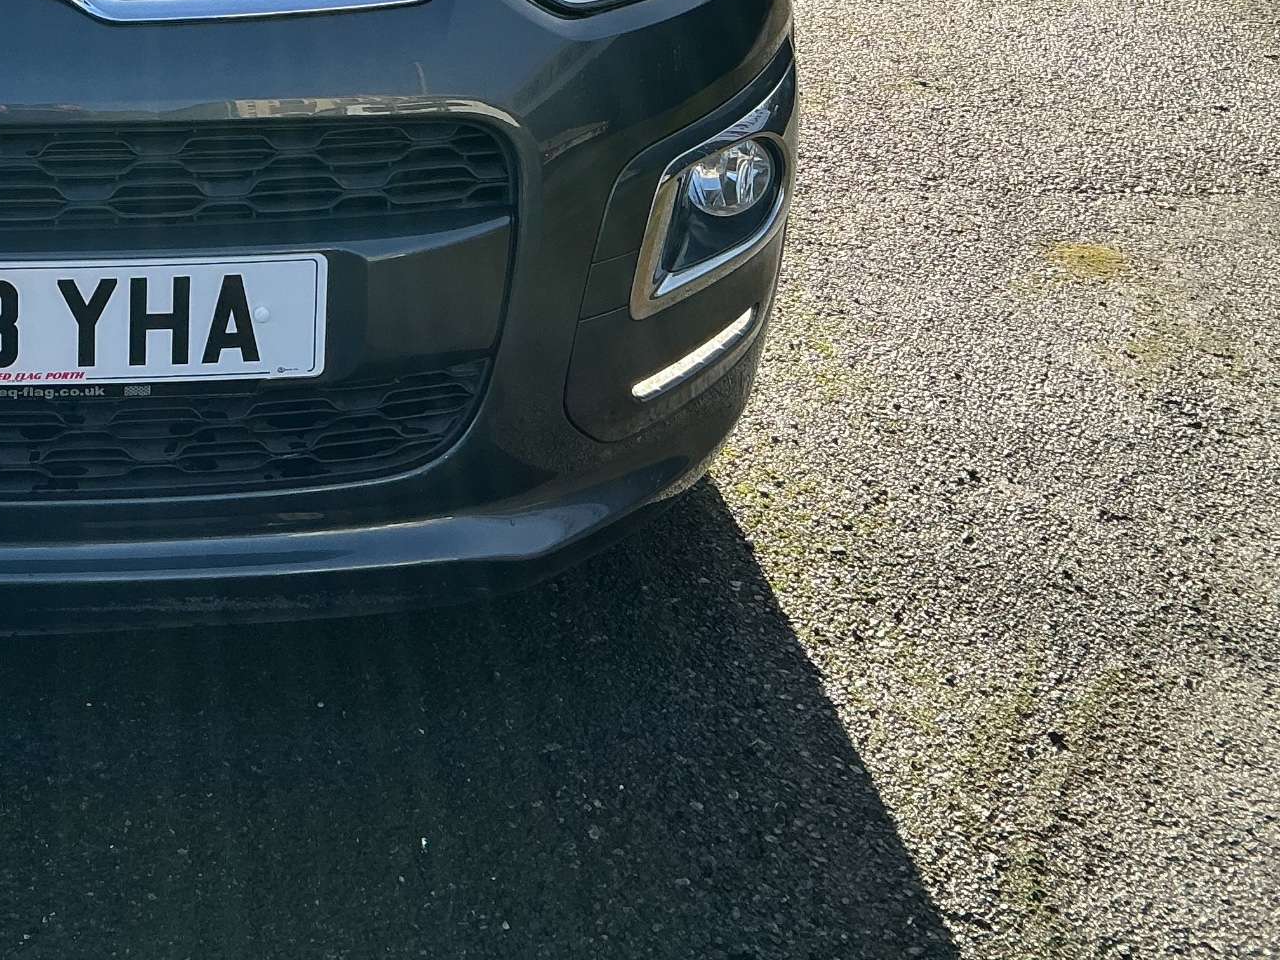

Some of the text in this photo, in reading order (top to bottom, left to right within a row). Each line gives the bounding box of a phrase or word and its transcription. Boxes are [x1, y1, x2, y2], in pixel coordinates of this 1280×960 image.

[57, 275, 260, 367] YHA
[15, 372, 42, 381] FLAG
[46, 371, 85, 380] PORTH
